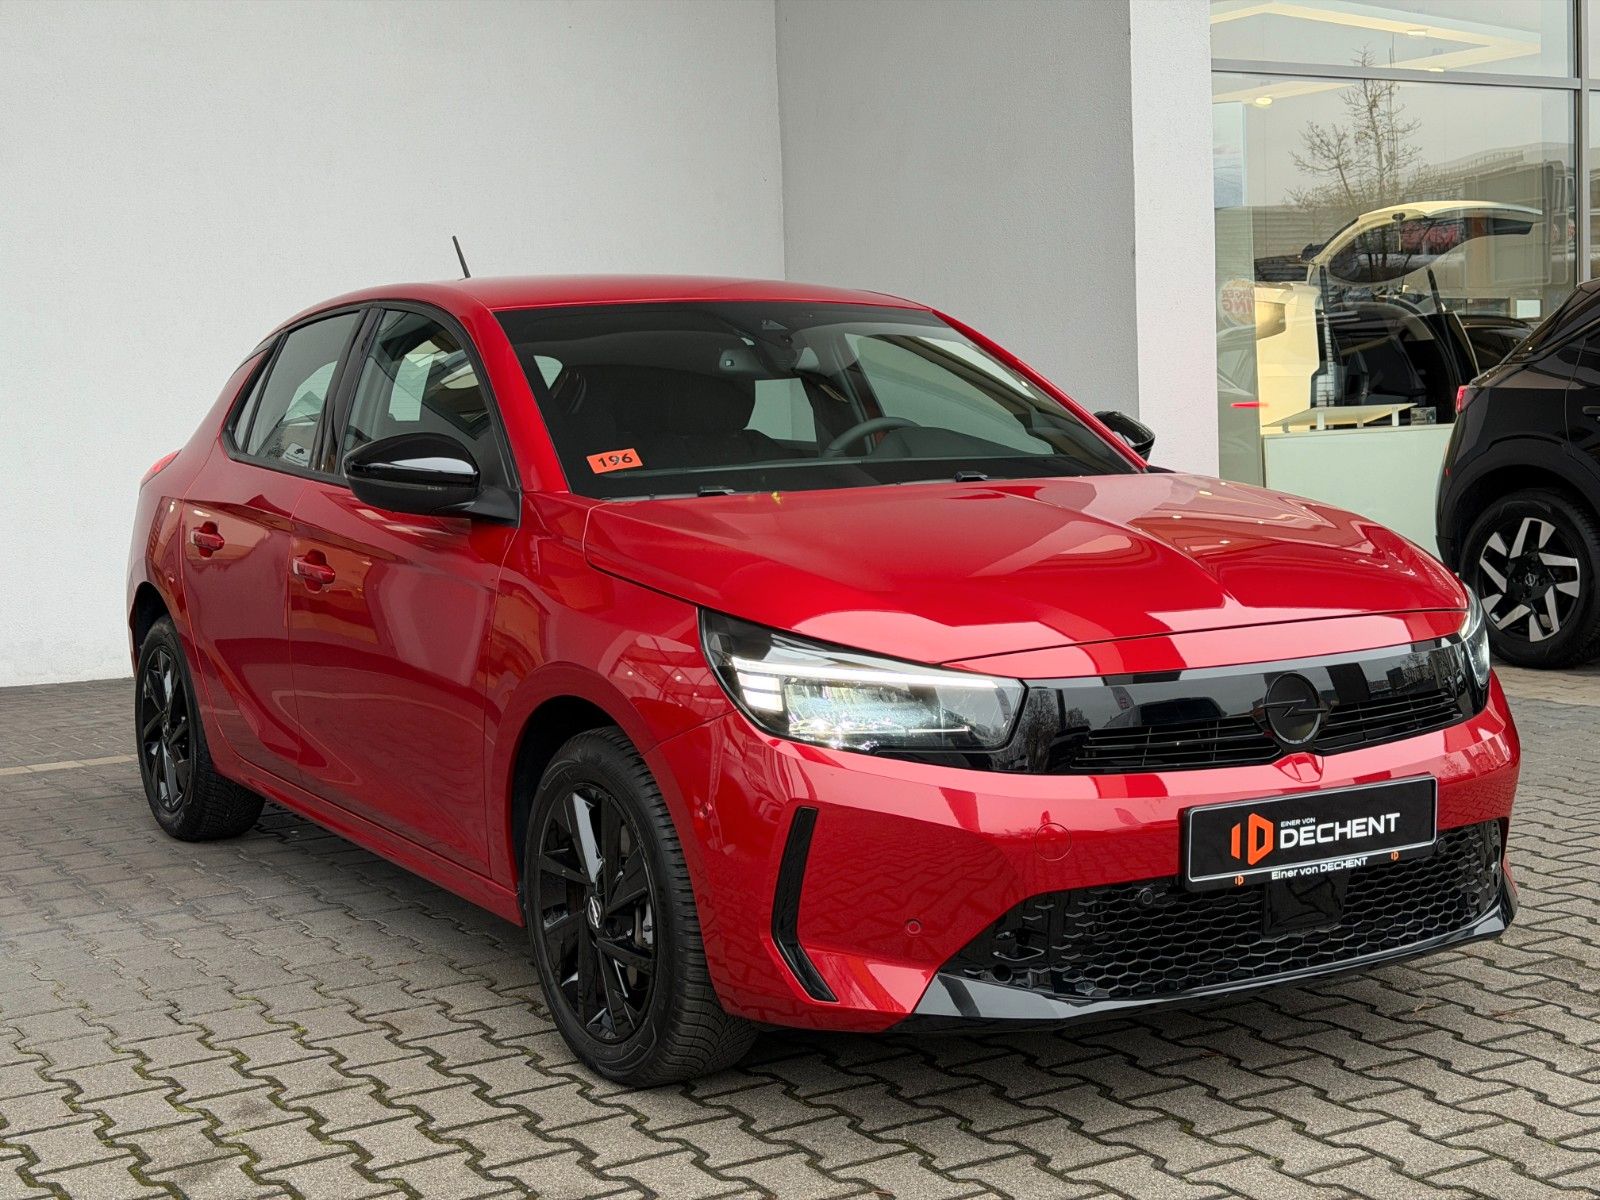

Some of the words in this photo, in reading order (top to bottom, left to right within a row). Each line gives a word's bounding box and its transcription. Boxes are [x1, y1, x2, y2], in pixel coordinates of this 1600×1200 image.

[598, 453, 633, 468] 196
[1280, 819, 1301, 828] EINER
[1302, 817, 1316, 825] VON
[1280, 812, 1401, 849] DECHENT
[1271, 868, 1298, 880] Einer
[1300, 866, 1319, 876] von
[1320, 856, 1369, 873] DECHENT
